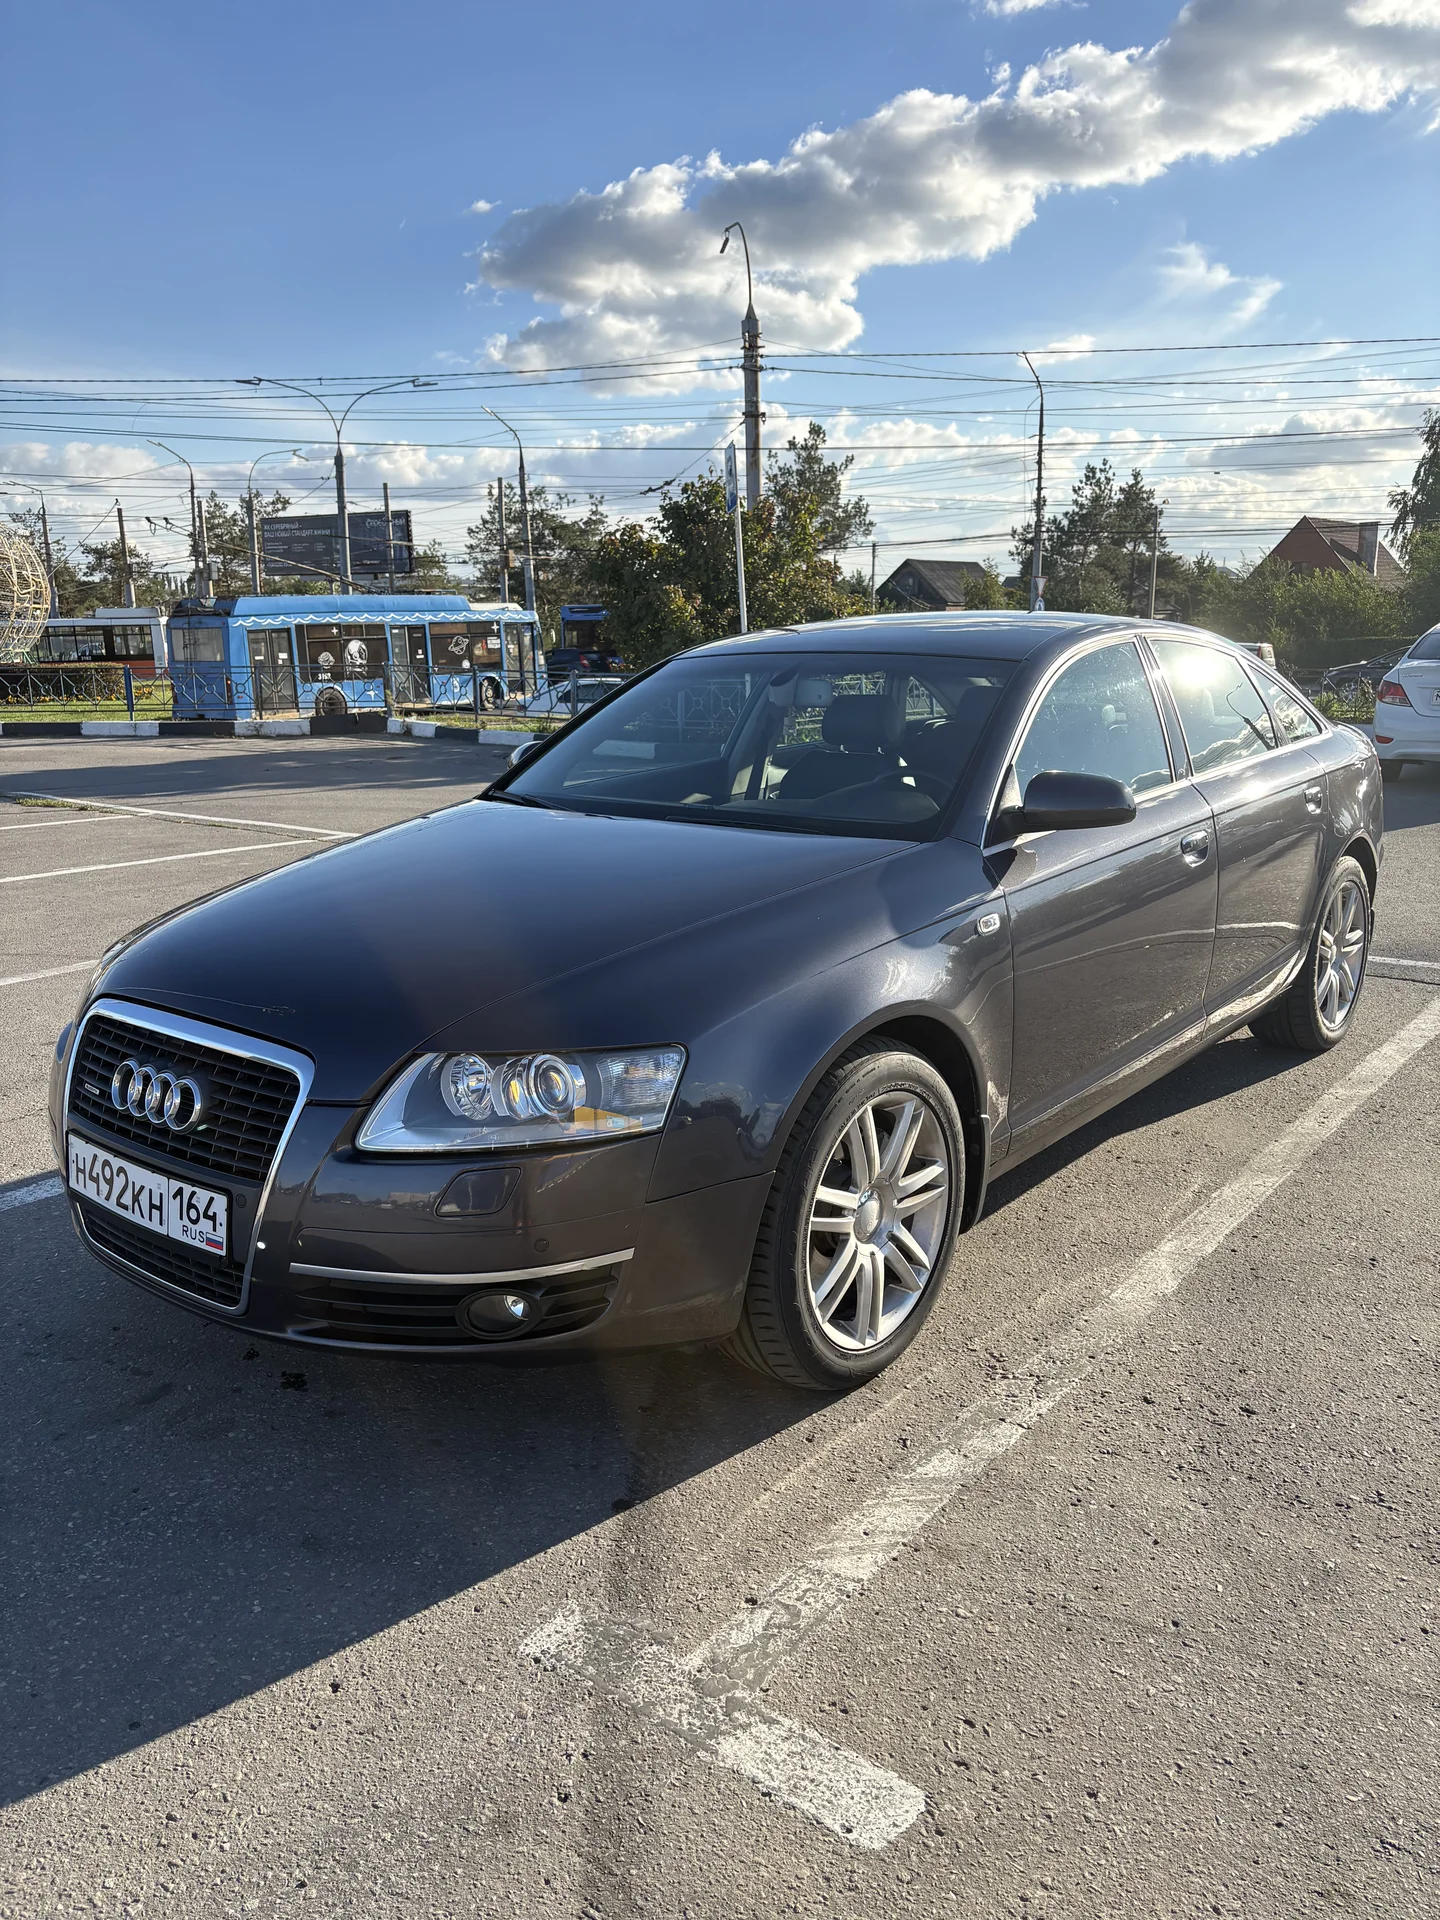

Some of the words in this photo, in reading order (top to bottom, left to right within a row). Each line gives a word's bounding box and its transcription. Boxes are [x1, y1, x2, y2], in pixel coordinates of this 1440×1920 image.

[291, 529, 313, 537] СТАНДАРТ
[171, 1186, 218, 1233] 164
[181, 1225, 205, 1243] RUS
